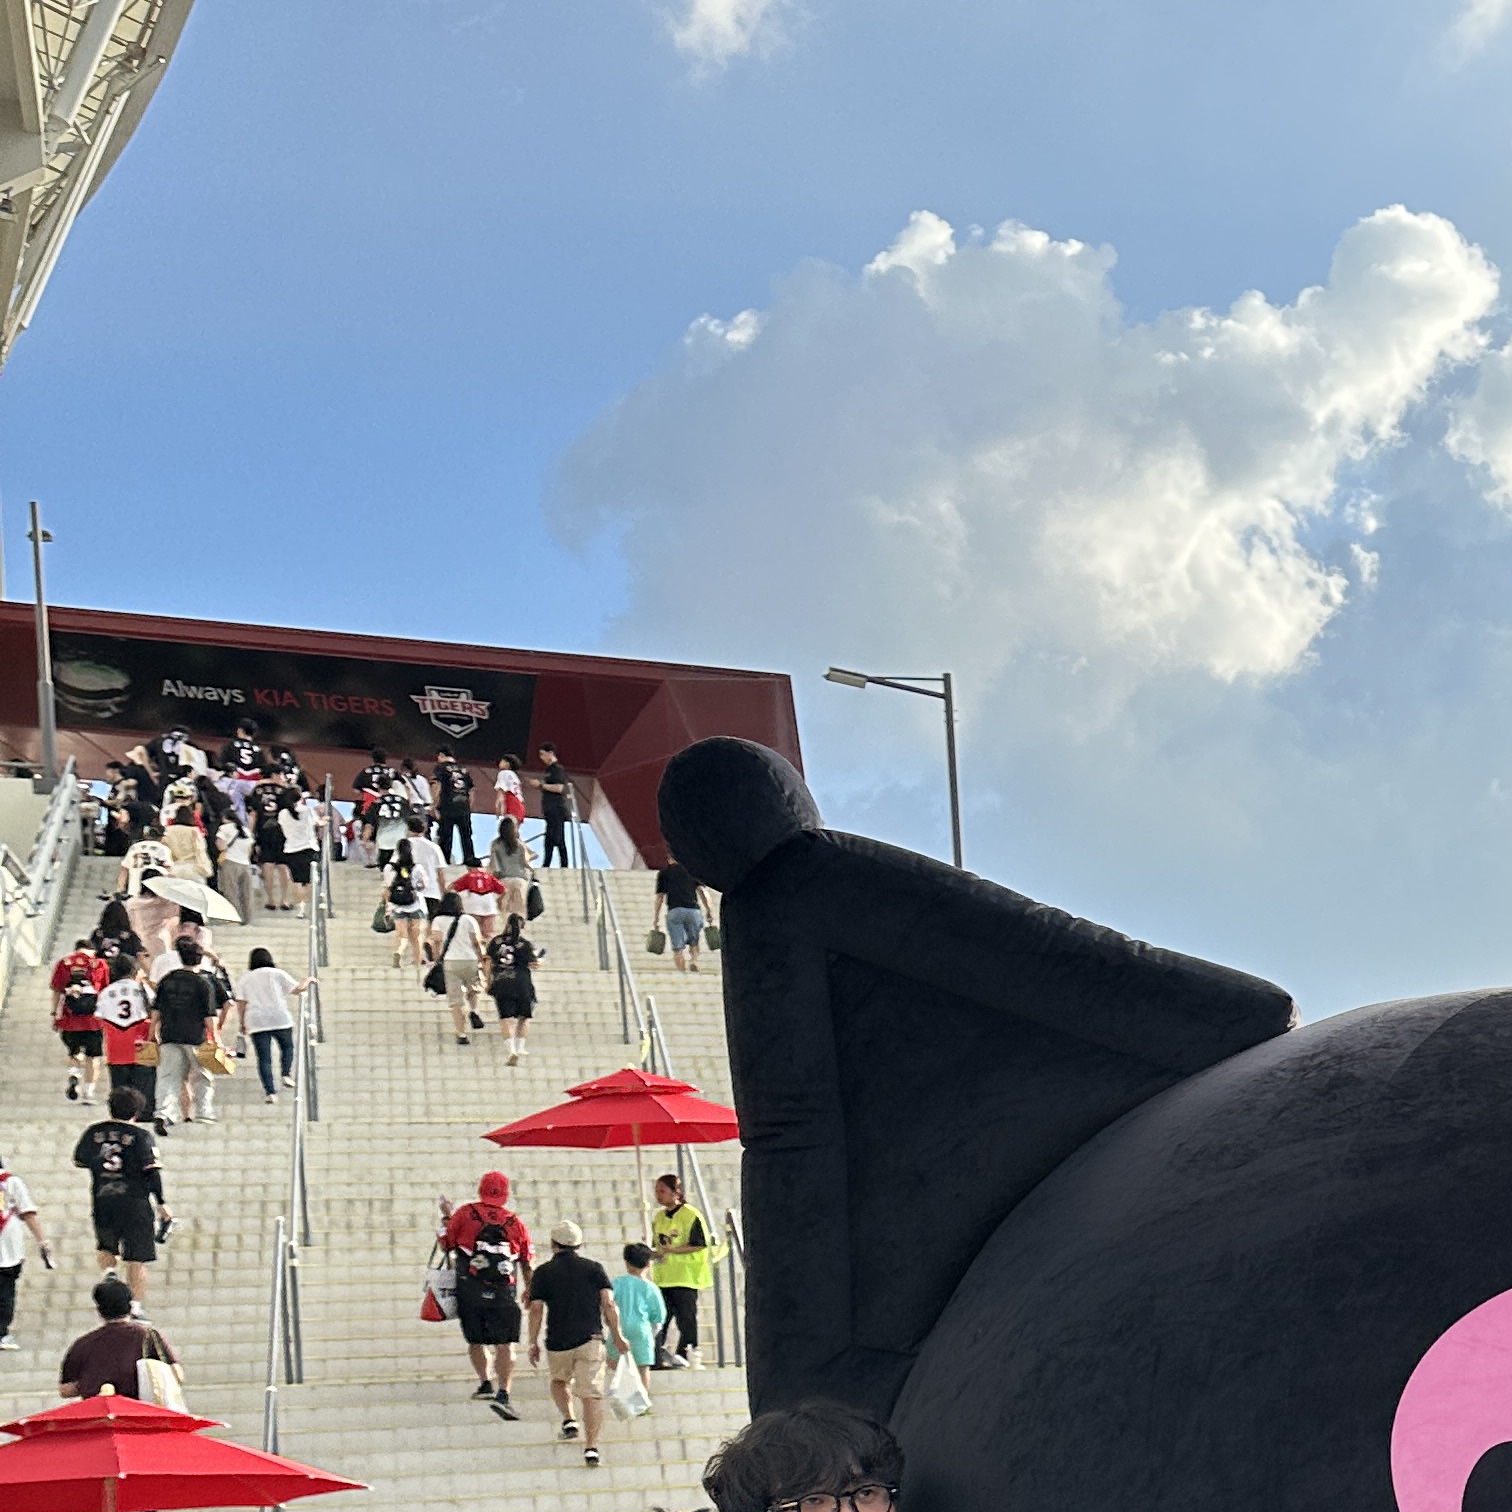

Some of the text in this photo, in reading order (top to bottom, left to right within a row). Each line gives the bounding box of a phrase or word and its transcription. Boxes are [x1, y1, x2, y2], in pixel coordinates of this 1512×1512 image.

[161, 678, 396, 717] Always KIA TIGERS
[415, 697, 487, 717] TIGERS
[118, 1000, 132, 1019] 3
